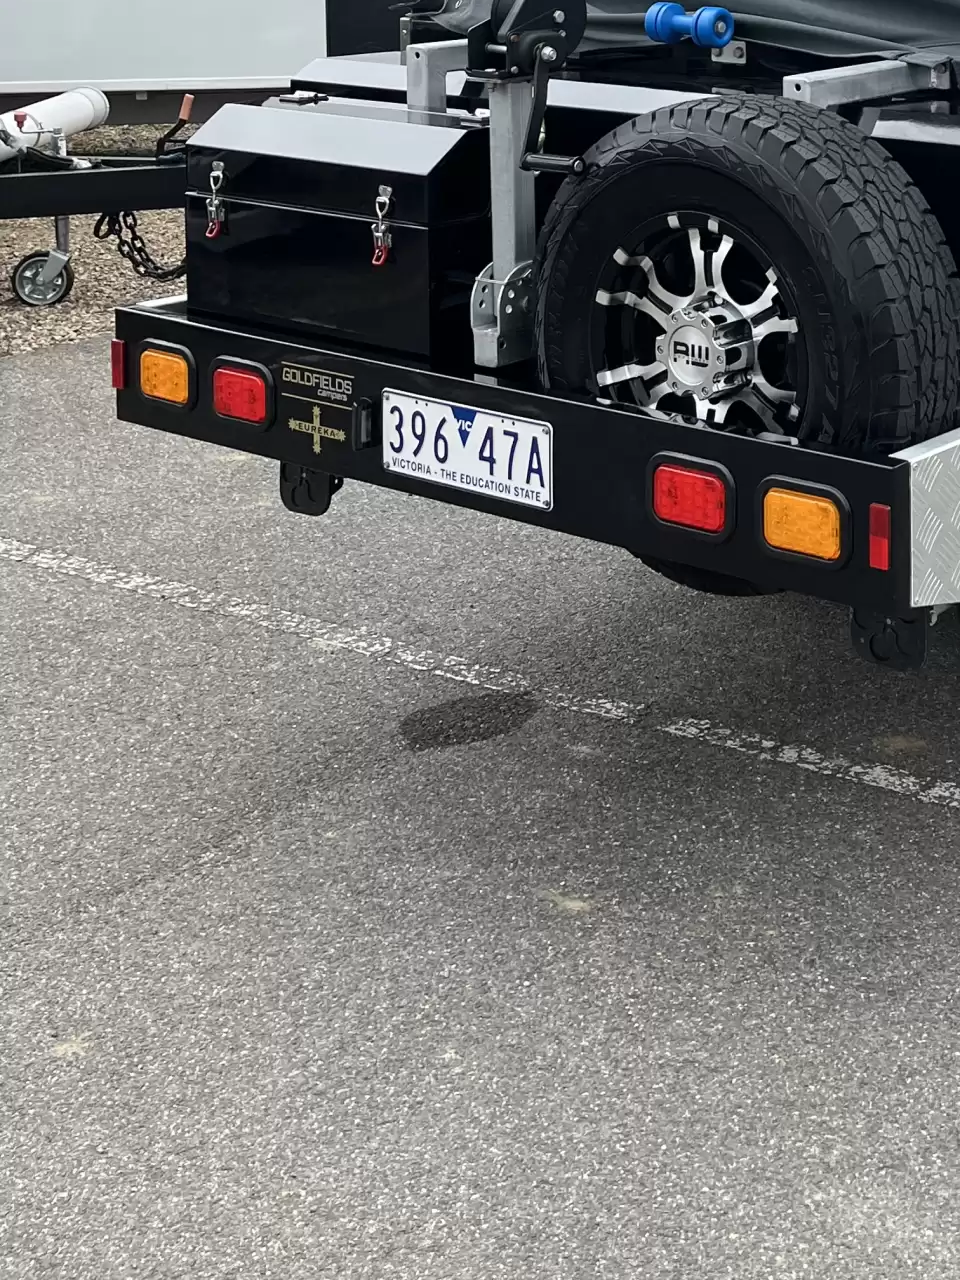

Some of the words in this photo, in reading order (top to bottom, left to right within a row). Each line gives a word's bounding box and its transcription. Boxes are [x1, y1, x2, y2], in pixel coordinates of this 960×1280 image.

[282, 367, 352, 394] GOLDFIELDS
[317, 389, 347, 401] campers
[298, 422, 336, 438] EUREKA
[457, 419, 473, 432] VIC
[389, 405, 449, 464] 396
[478, 426, 545, 488] 47A
[391, 456, 432, 476] VICTORIA
[440, 468, 457, 482] THE
[460, 473, 511, 495] EDUCATION
[513, 486, 541, 502] STATE
